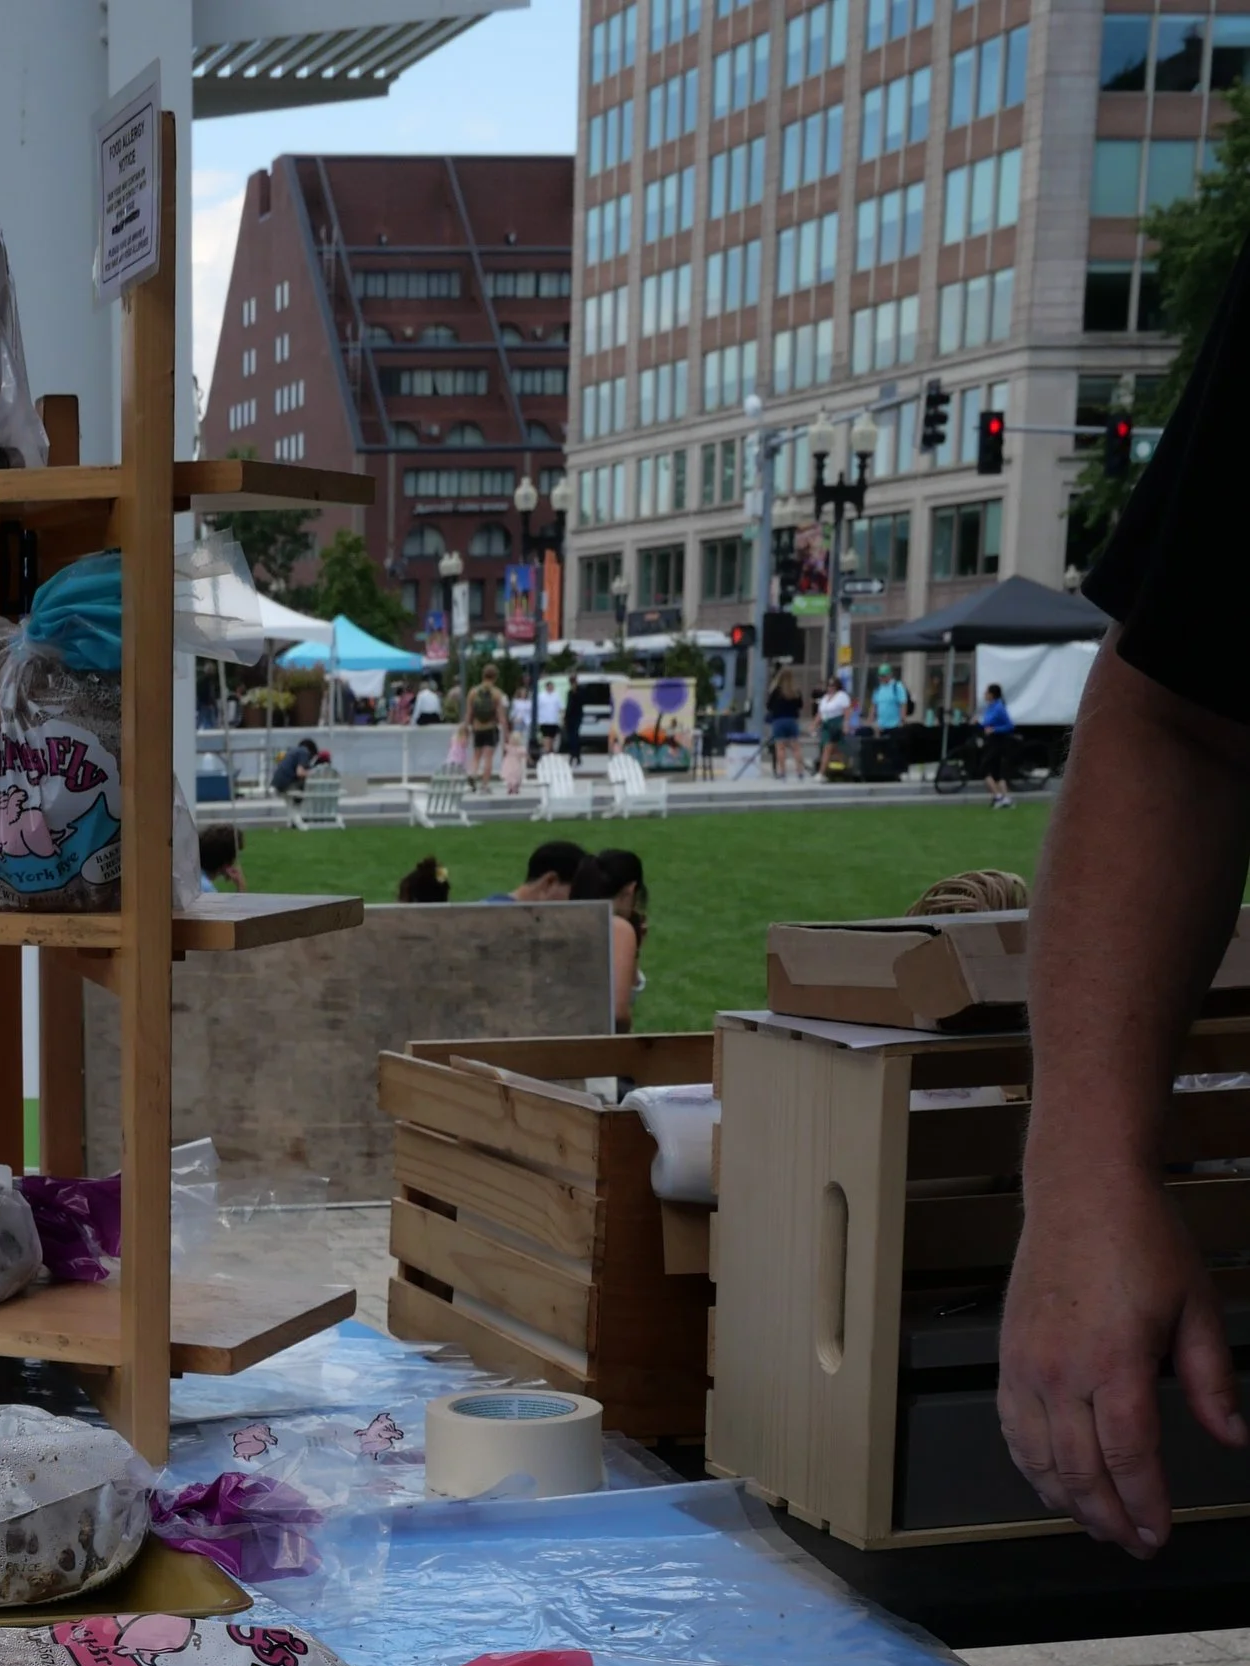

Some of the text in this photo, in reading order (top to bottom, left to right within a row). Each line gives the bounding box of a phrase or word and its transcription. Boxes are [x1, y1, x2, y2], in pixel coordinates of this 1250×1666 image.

[46, 736, 109, 793] Fly
[96, 846, 121, 863] BAK
[100, 856, 121, 872] FRE
[15, 868, 54, 883] York
